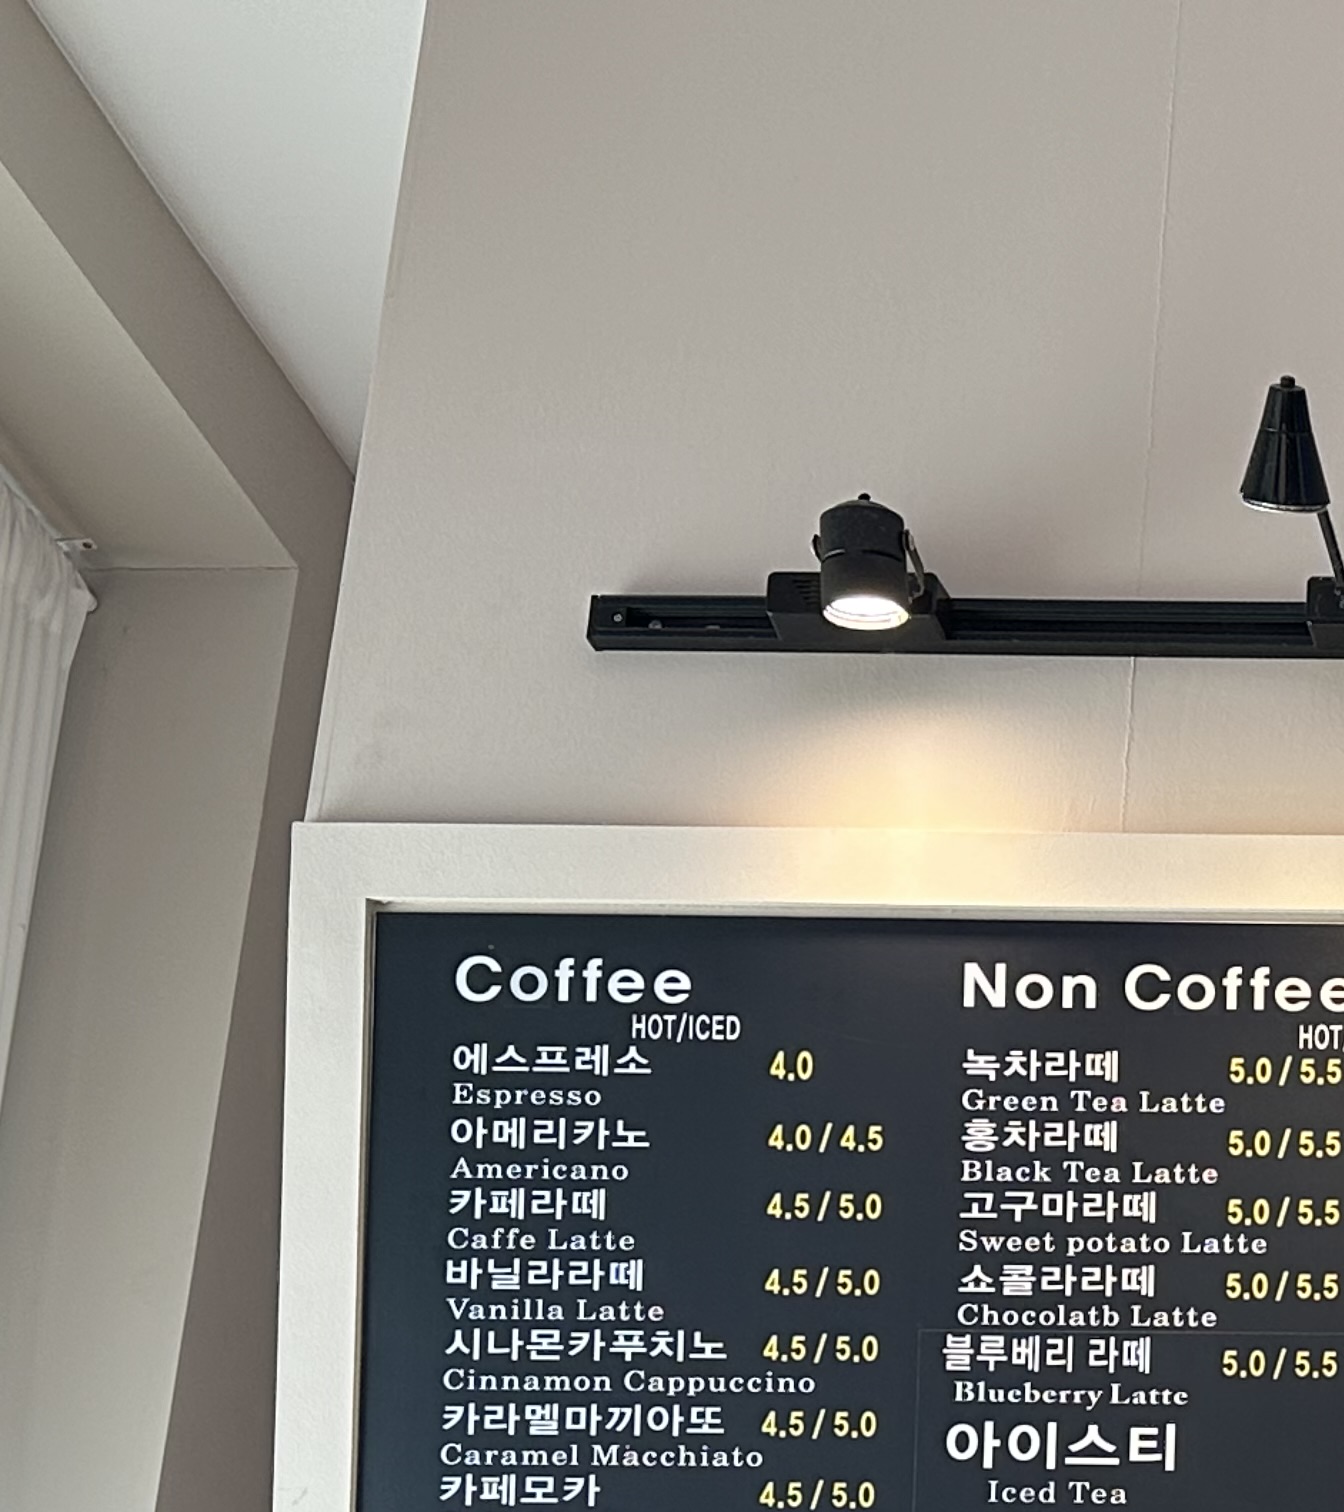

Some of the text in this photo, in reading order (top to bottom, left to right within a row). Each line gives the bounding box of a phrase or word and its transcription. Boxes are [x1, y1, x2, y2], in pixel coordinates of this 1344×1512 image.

[455, 954, 692, 1005] Coffee
[963, 961, 1097, 1010] Non
[631, 1011, 741, 1044] HOT/ICED
[453, 1042, 653, 1077] 에스프레소
[769, 1050, 814, 1082] 4.0
[961, 1048, 1119, 1083] 녹차라떼
[452, 1082, 602, 1109] Espresso
[961, 1088, 1226, 1114] Green Tea Latte
[450, 1116, 651, 1151] 아메리카노
[960, 1118, 1118, 1153] 홍차라떼
[449, 1156, 629, 1181] Americano
[448, 1186, 606, 1221] 카페라떼
[959, 1190, 1157, 1224] 고구마라떼
[958, 1228, 1268, 1257] Sweet potato Latte
[445, 1257, 644, 1292] 바닐라라떼
[957, 1263, 1156, 1298] 쇼콜라라떼
[1130, 1304, 1218, 1328] Latte
[444, 1327, 728, 1363] 시나몬카푸치노
[941, 1333, 1152, 1375] 블루베리 라떼
[442, 1368, 816, 1397] Cinnamon Cappuccino
[442, 1402, 725, 1438] 카라멜마끼아또
[946, 1420, 1176, 1472] 아이스티
[439, 1472, 601, 1507] 카페모카
